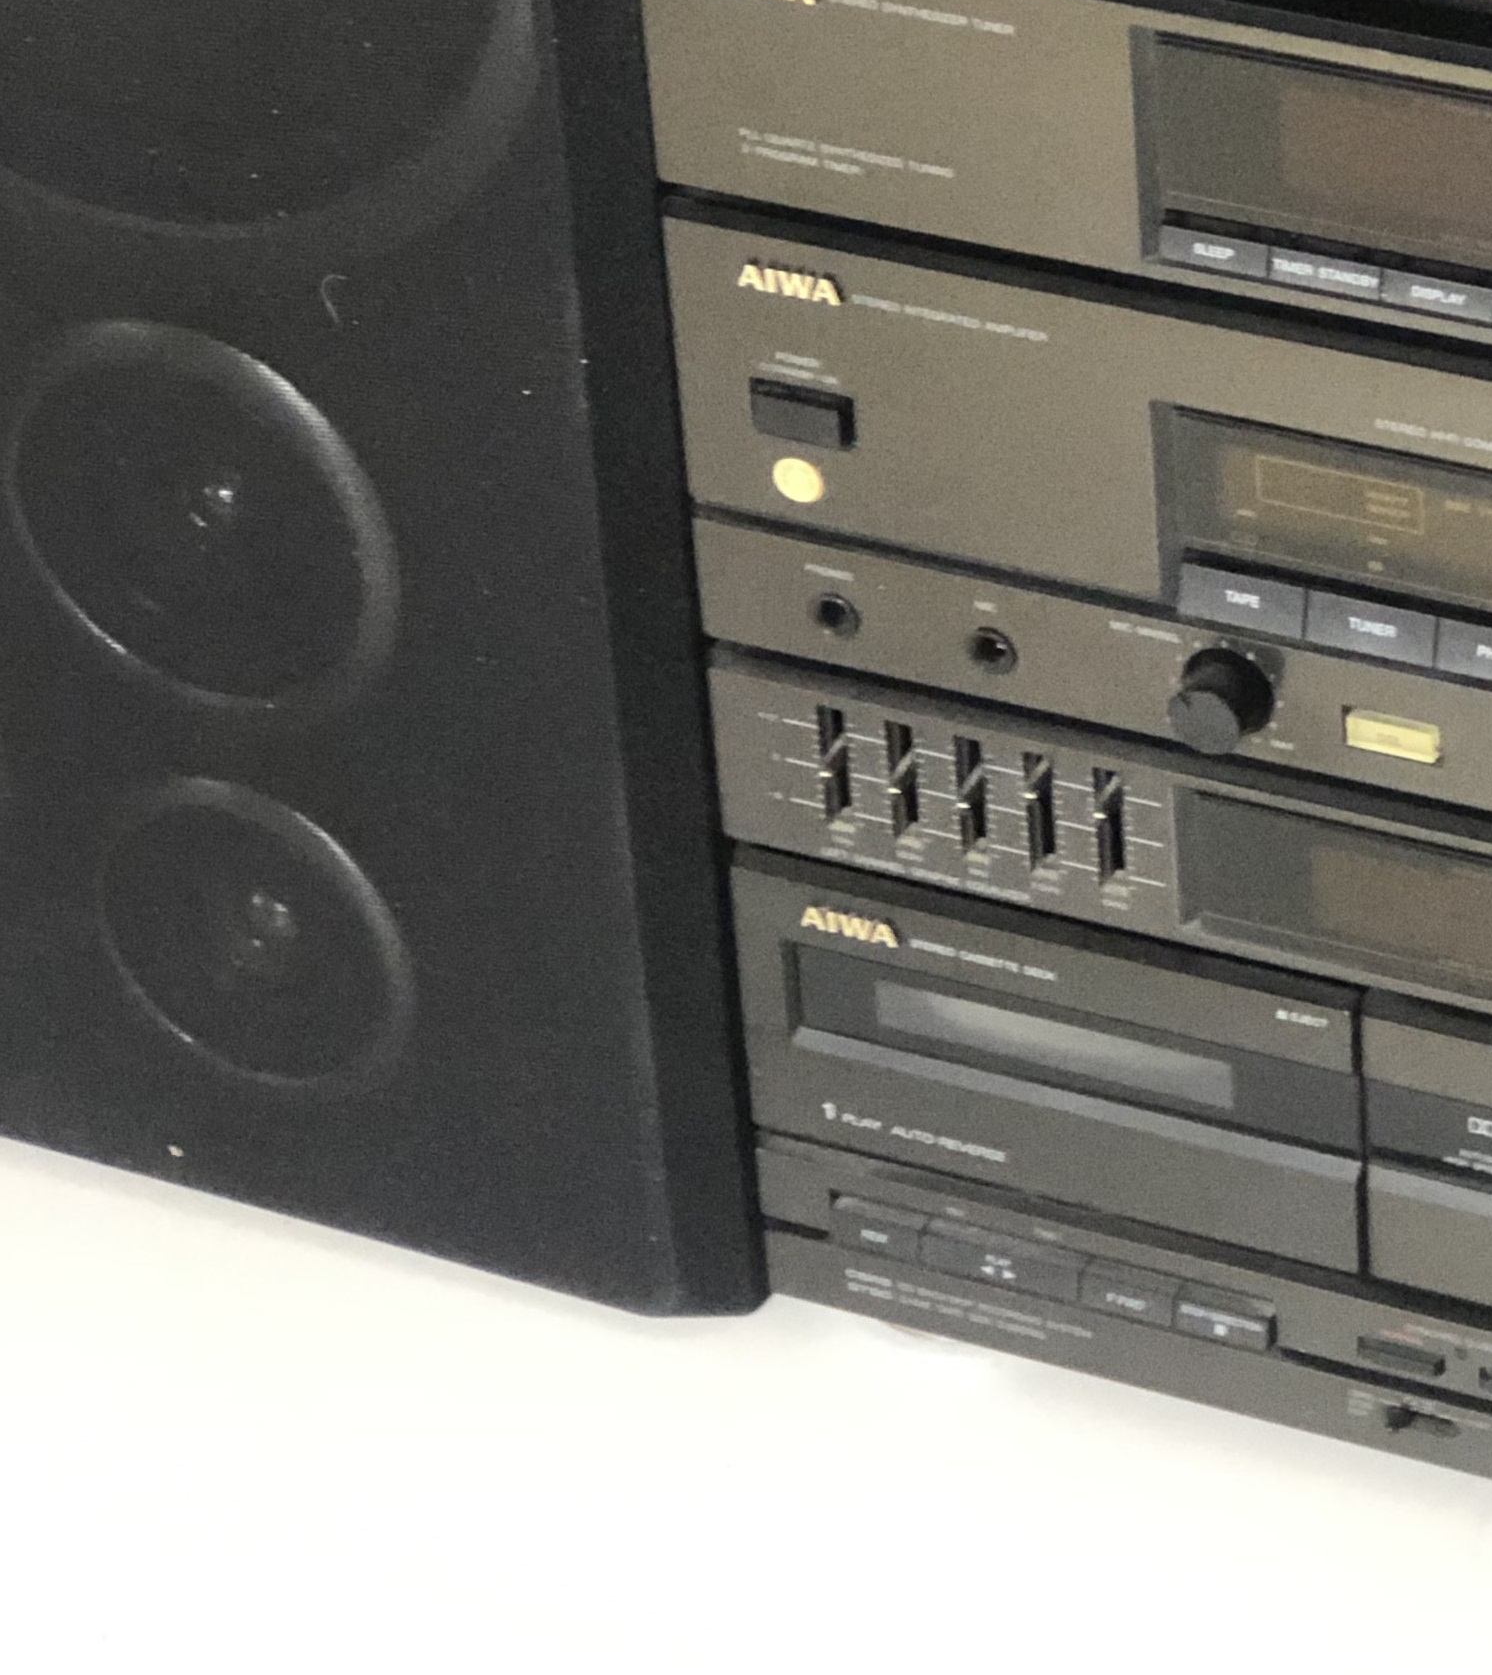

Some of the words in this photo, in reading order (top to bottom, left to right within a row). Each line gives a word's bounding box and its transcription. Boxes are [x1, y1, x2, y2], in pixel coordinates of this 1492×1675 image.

[1193, 242, 1235, 260] SLEEP
[738, 262, 841, 306] AIWA
[1224, 589, 1261, 610] TAPE
[1348, 616, 1398, 639] TUNER
[800, 905, 900, 950] AIWA
